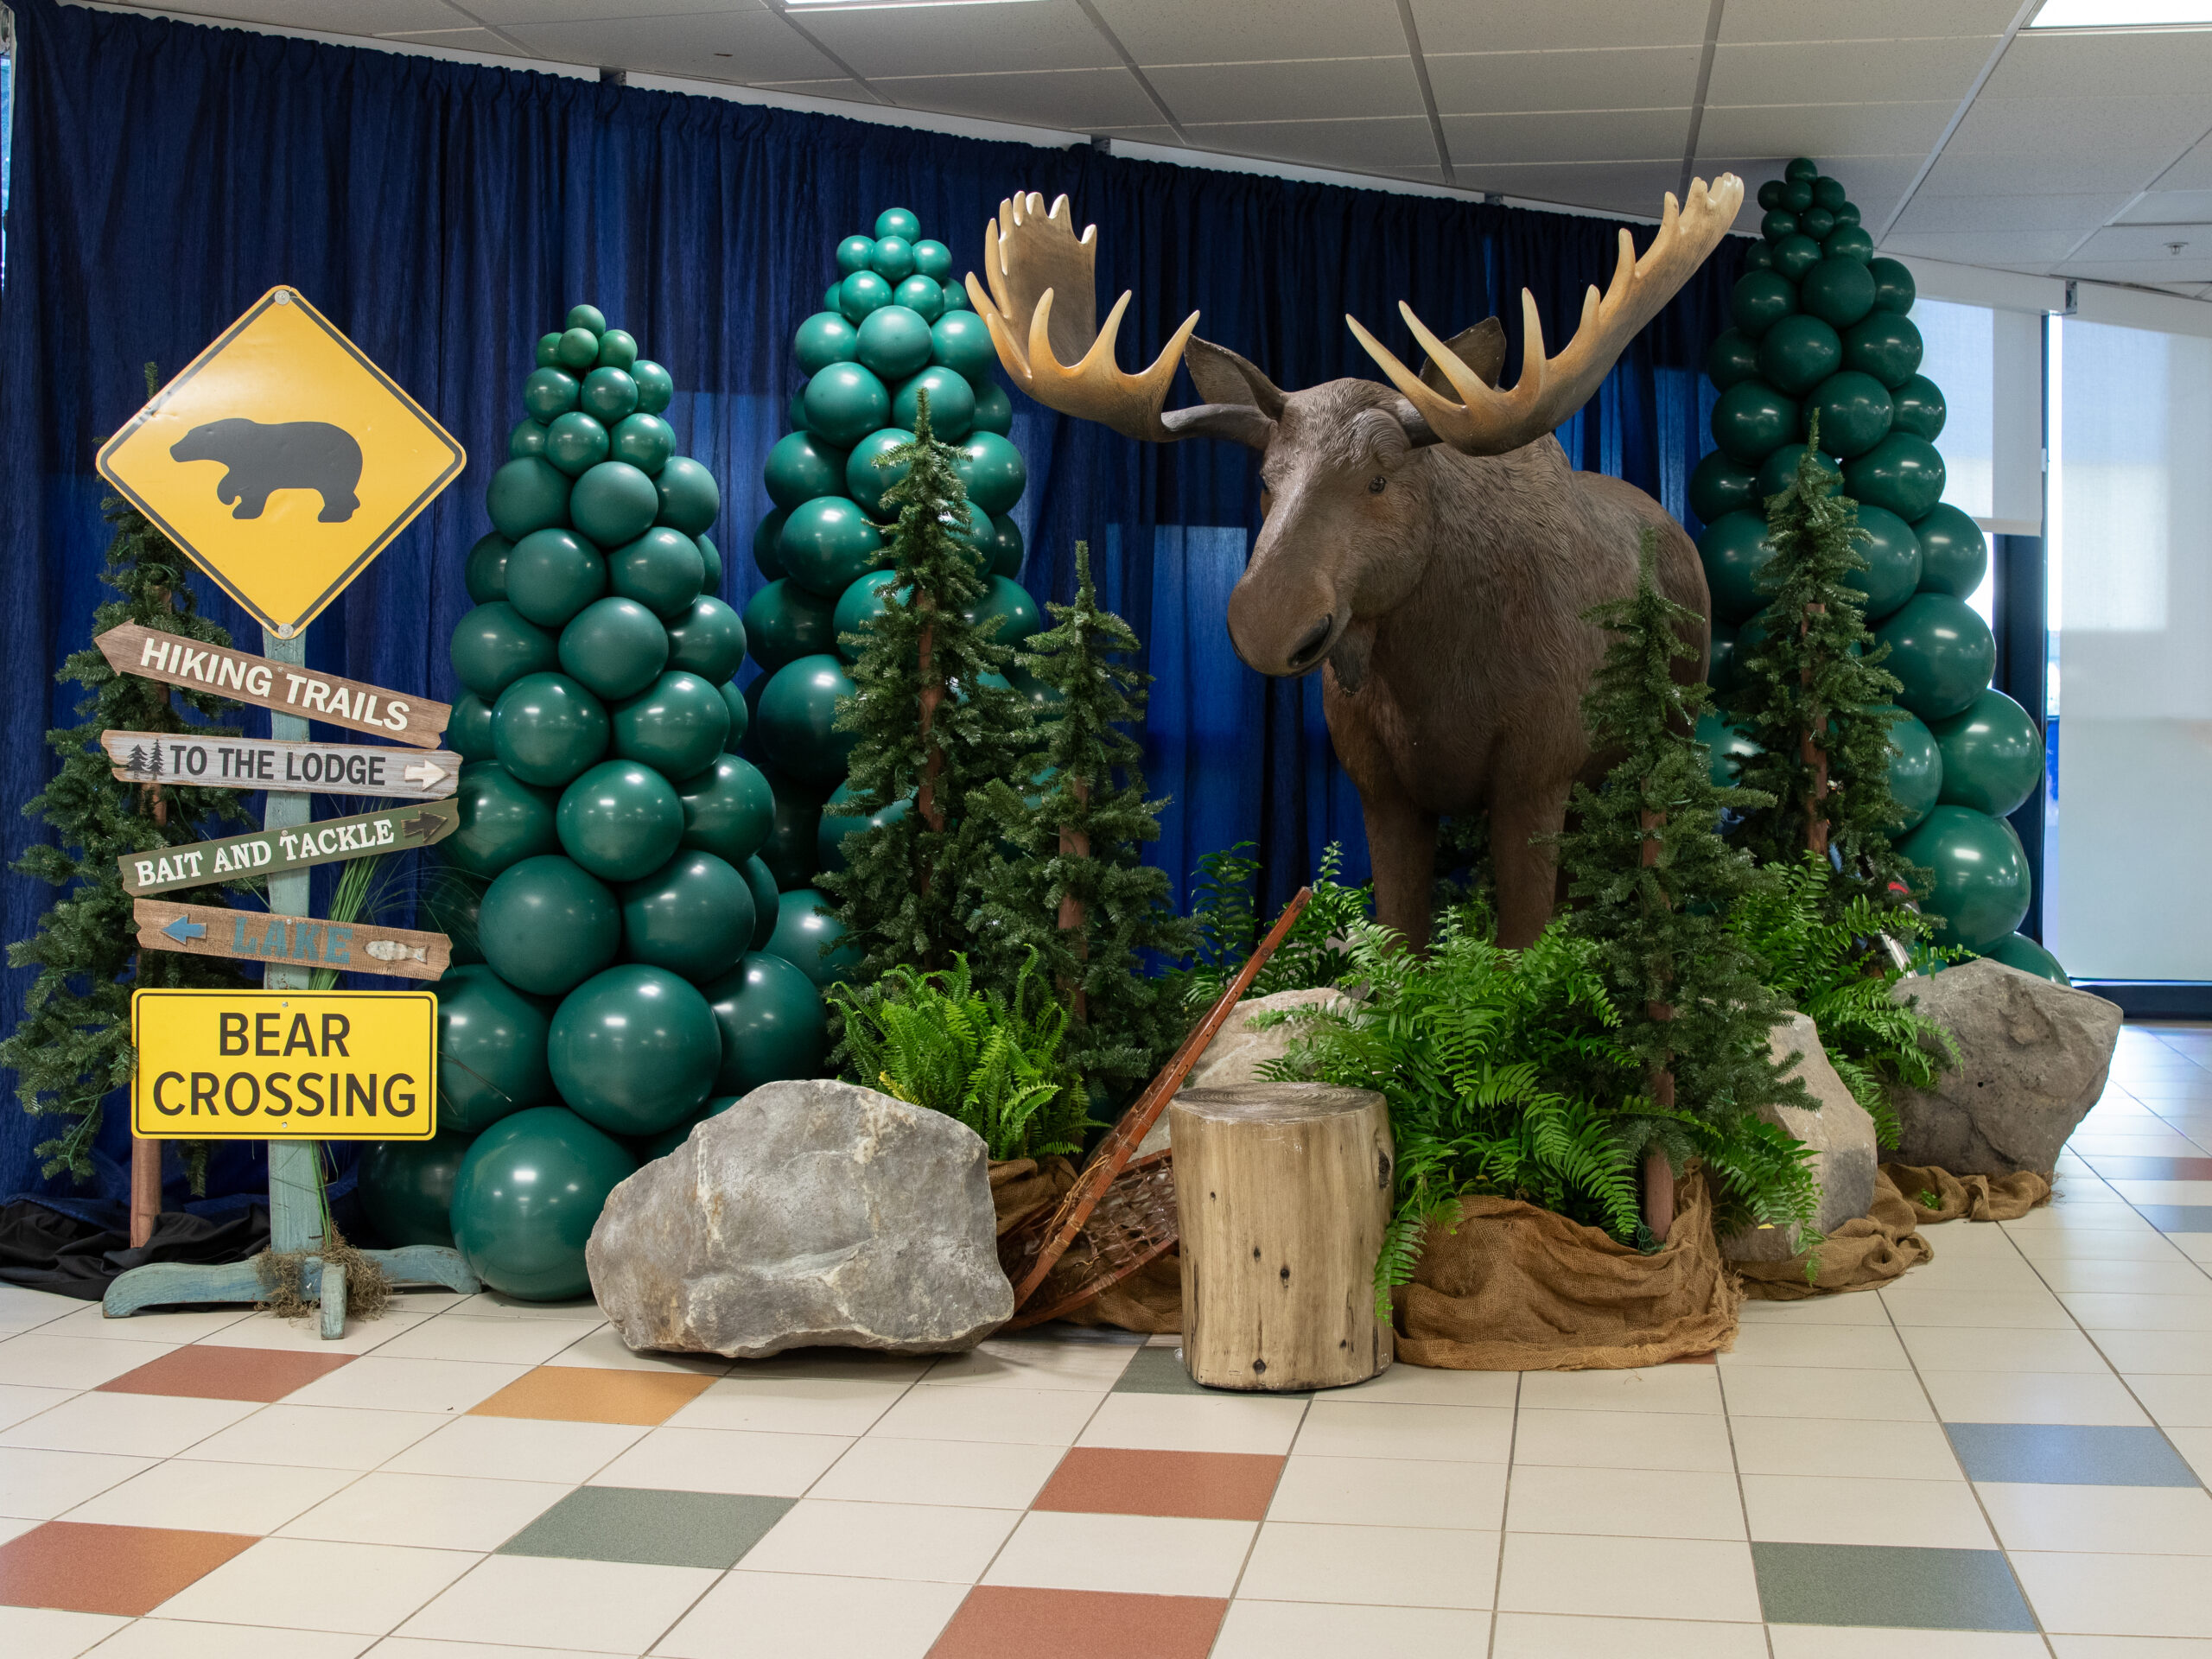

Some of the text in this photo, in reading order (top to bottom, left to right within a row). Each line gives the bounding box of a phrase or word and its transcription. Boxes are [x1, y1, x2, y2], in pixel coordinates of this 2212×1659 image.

[140, 637, 410, 732] HIKING TRAILS
[169, 745, 386, 786] TO THE LODGE
[134, 819, 395, 887] BAIT AND TACKLE
[232, 916, 353, 964] LAKE
[219, 1012, 351, 1058] BEAR
[153, 1071, 416, 1118] CROSSING
